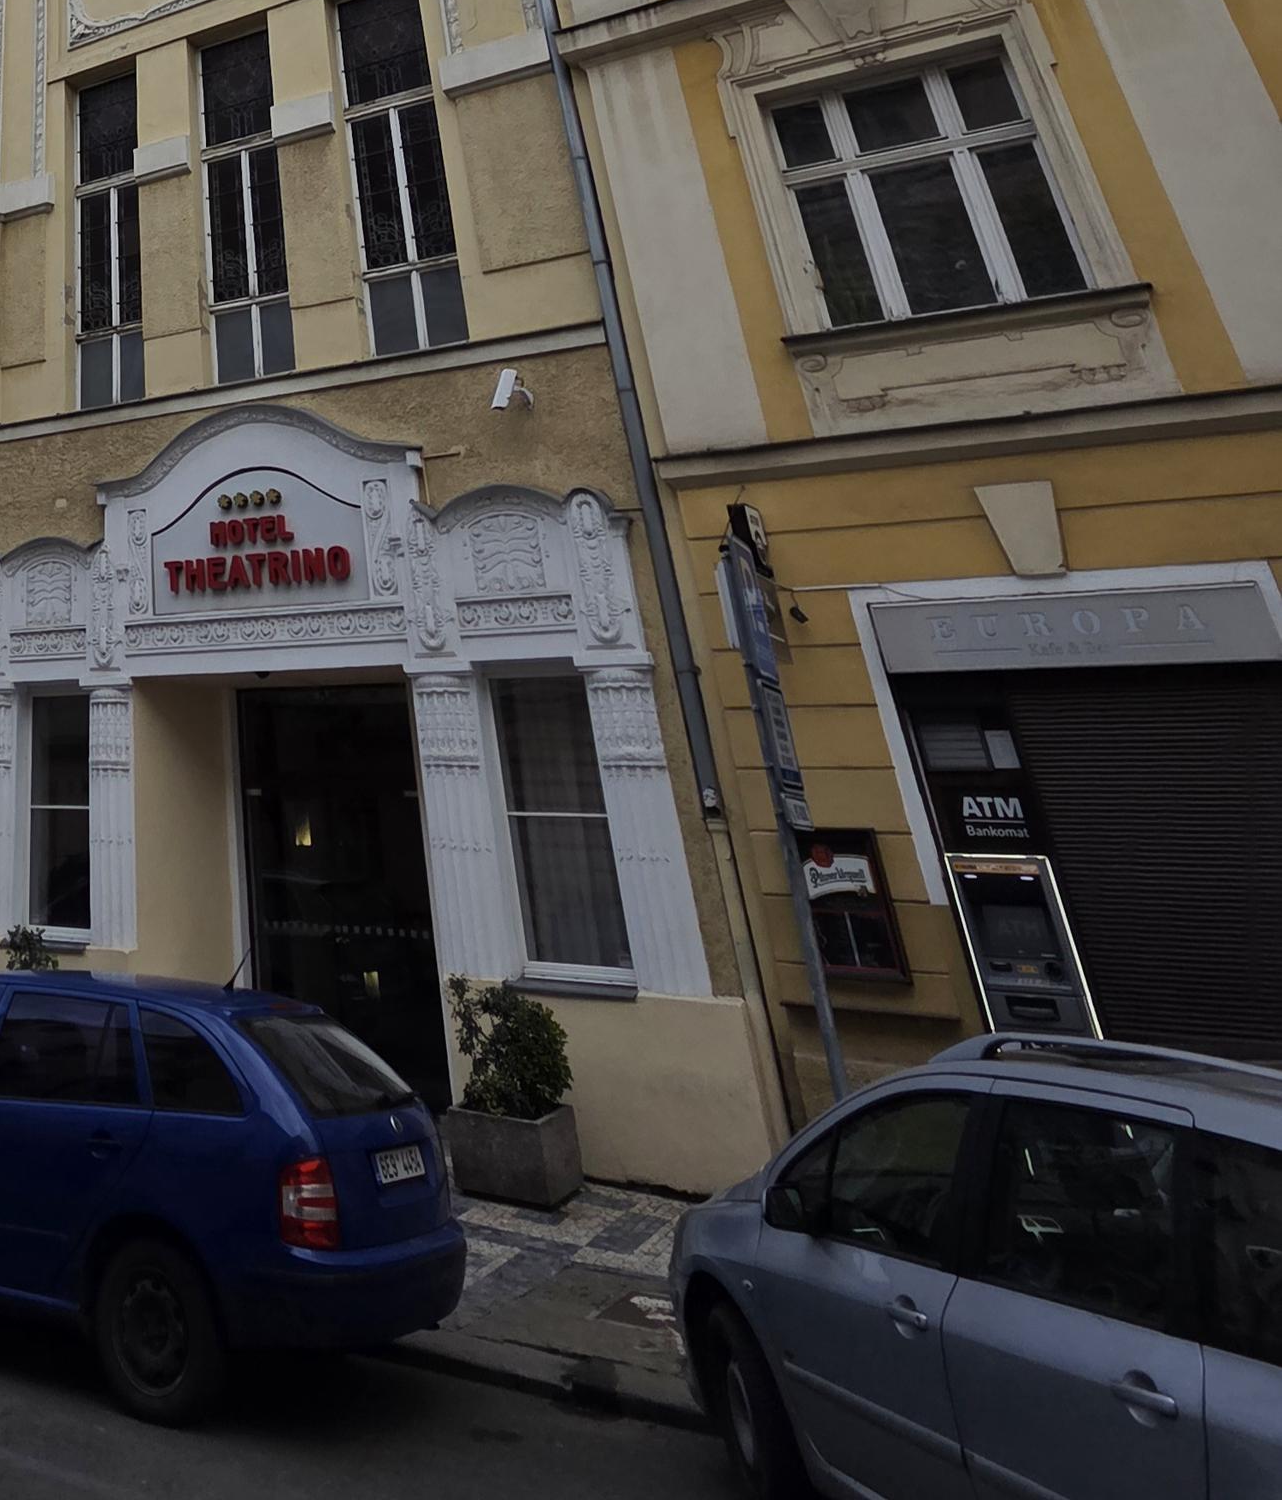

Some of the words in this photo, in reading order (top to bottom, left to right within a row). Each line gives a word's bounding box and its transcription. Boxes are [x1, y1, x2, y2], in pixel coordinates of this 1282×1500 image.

[209, 514, 295, 548] HOTEL
[164, 545, 351, 594] THEATRINO
[926, 604, 1207, 642] EUROPA
[962, 796, 1024, 819] ATM
[966, 824, 1031, 838] Bankomat
